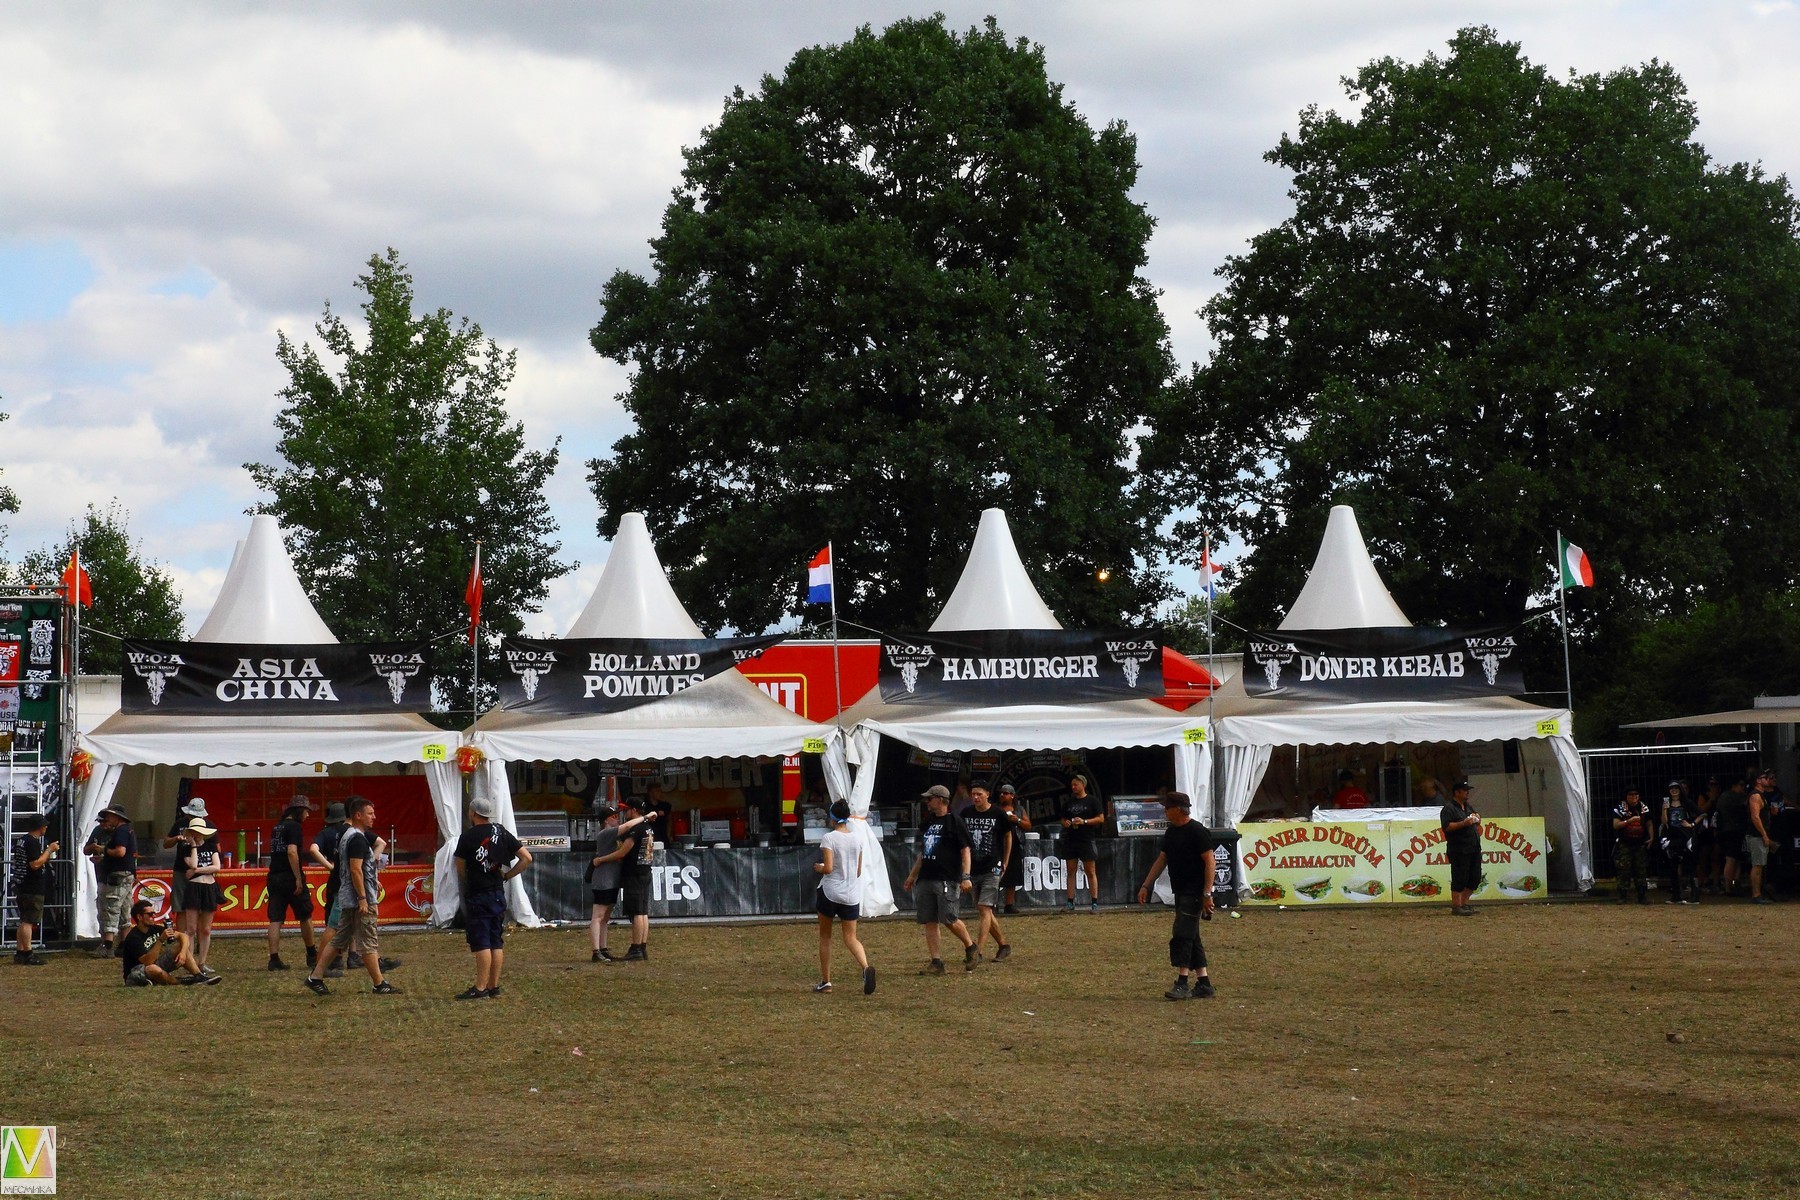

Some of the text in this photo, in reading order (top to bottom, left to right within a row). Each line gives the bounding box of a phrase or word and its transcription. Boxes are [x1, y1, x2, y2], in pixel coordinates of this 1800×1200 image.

[232, 657, 324, 679] ASIA
[588, 652, 701, 672] HOLLAND
[941, 654, 1100, 682] HAMBURGER
[1299, 651, 1465, 682] DÖNER KEBAB
[216, 679, 339, 702] CHINA
[753, 682, 800, 713] NT
[0, 711, 17, 719] USE
[1243, 825, 1385, 871] DÖNER DÜRÜM
[1269, 855, 1356, 869] LAHMACUN
